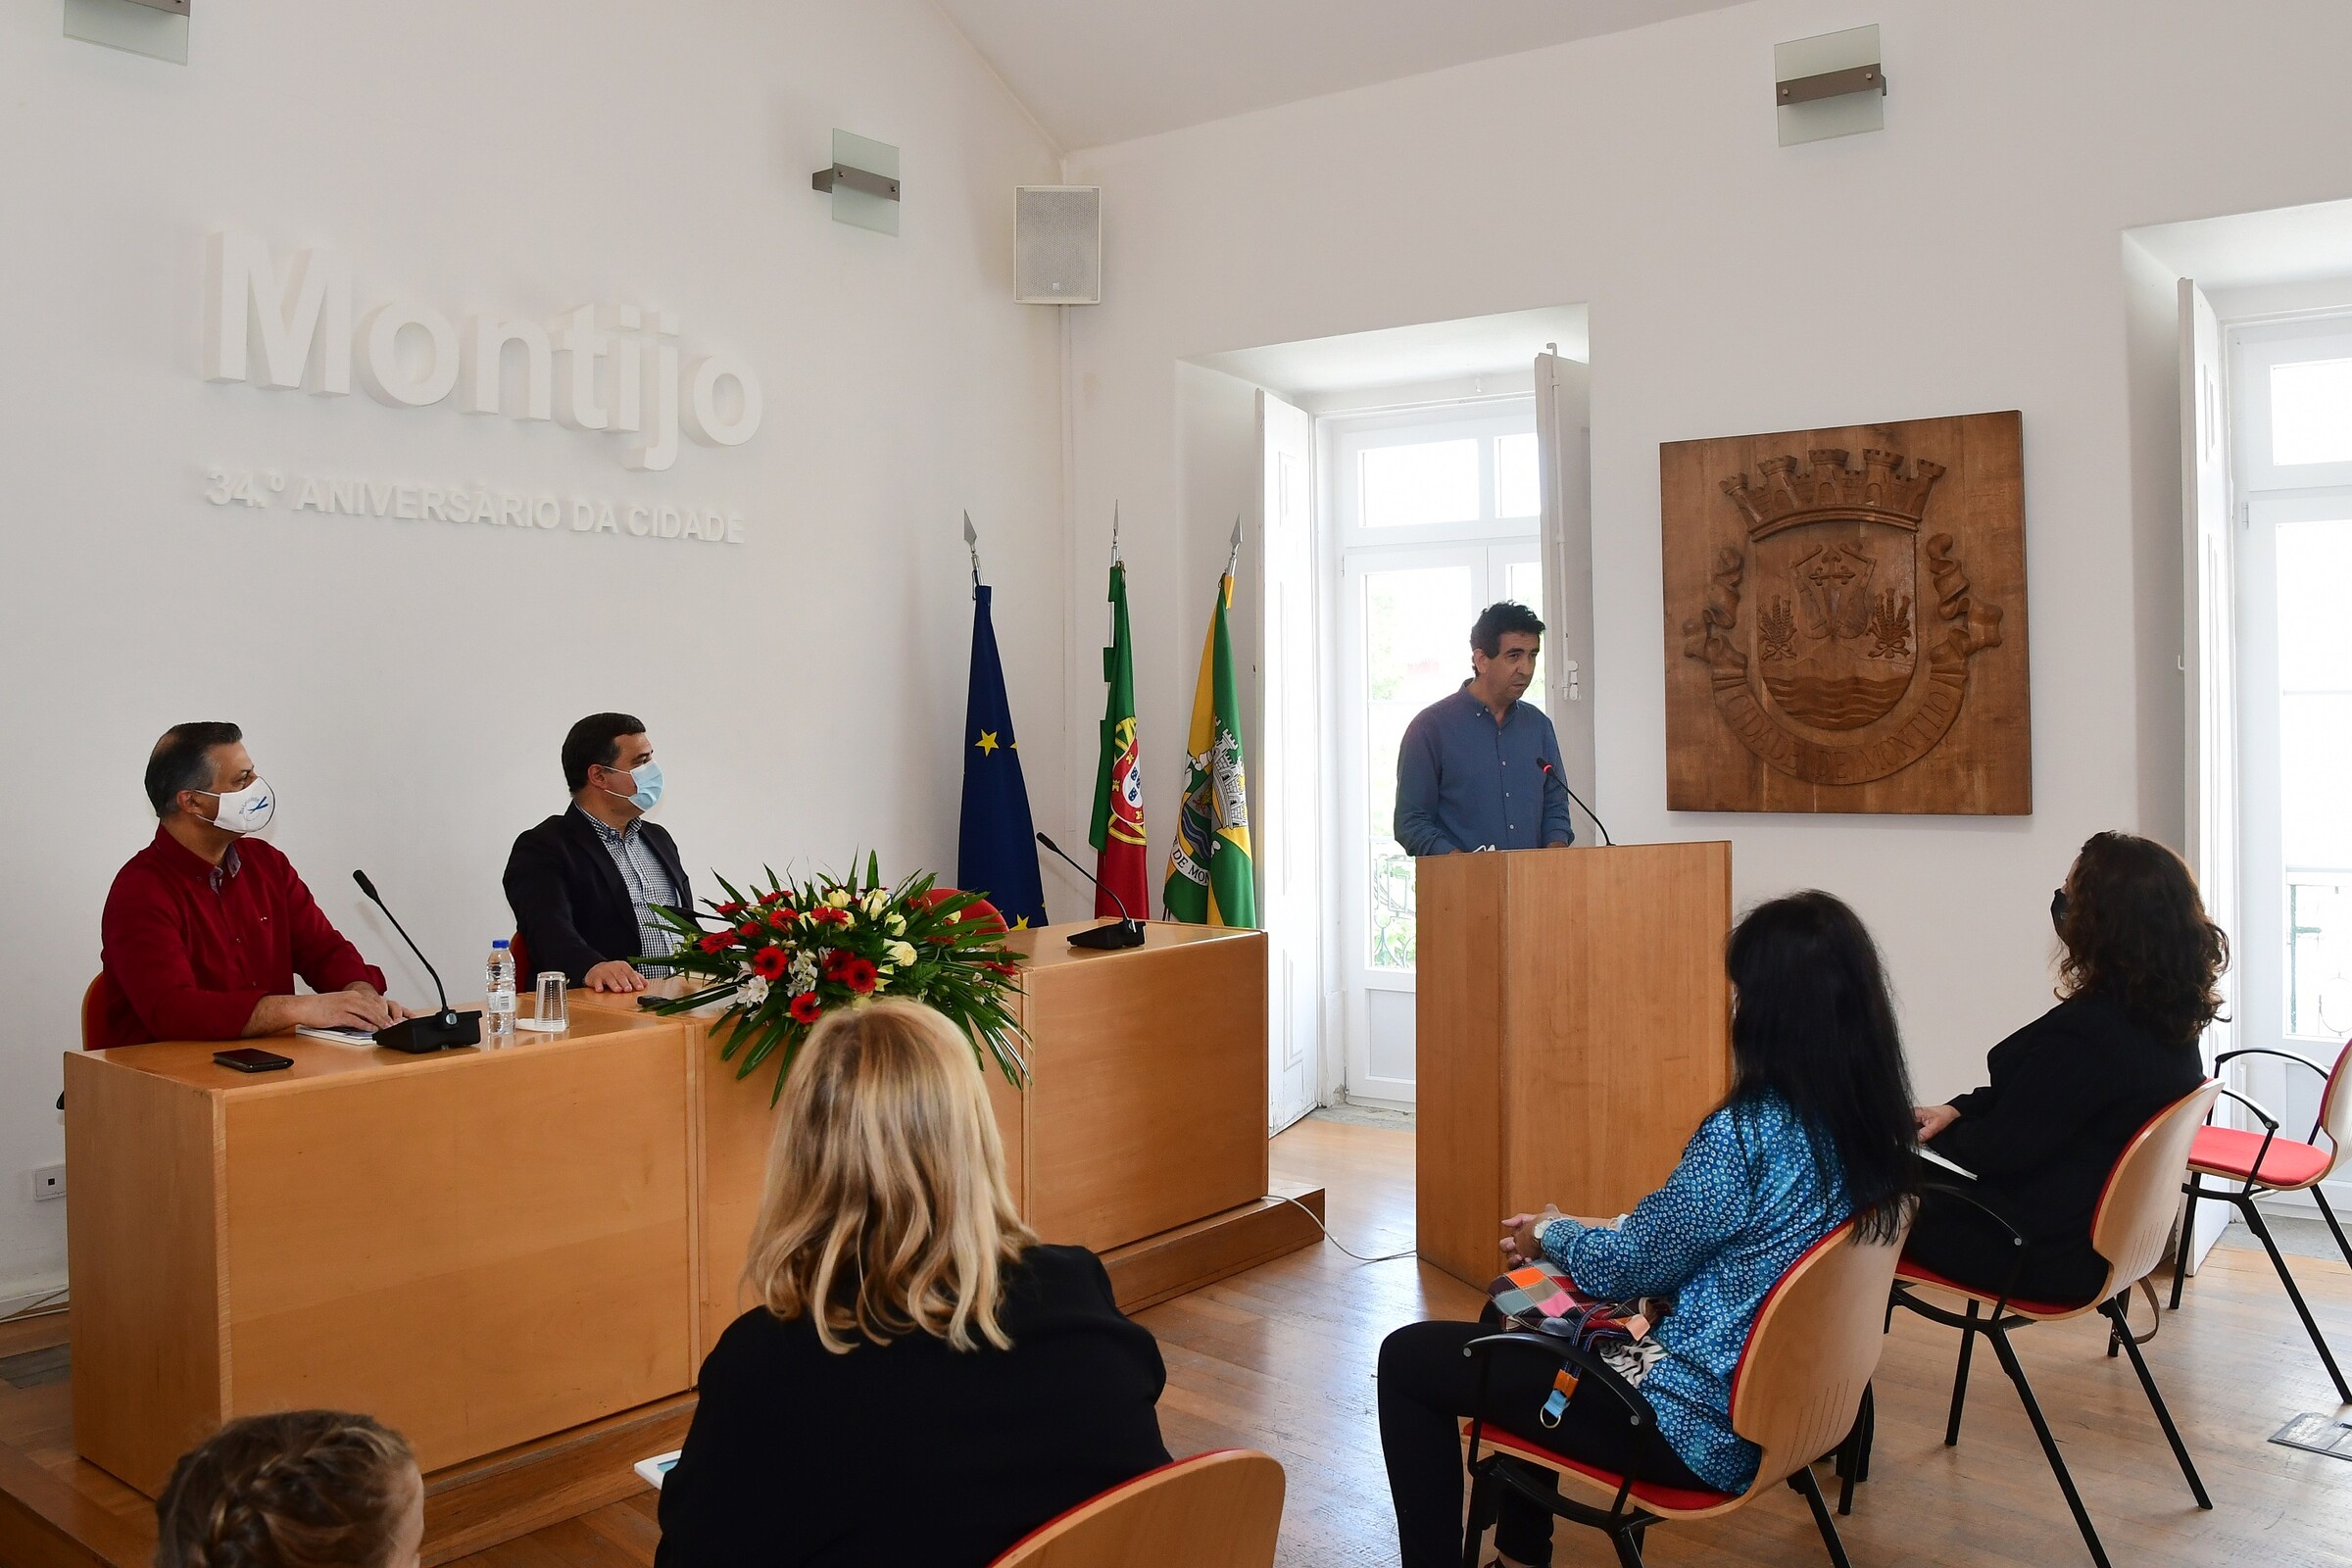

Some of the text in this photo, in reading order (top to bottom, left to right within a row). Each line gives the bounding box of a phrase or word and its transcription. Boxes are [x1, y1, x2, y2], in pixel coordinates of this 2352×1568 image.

[203, 229, 763, 472] Montijo
[292, 471, 561, 529] ANIVERSÁRIO
[570, 497, 619, 534] DA
[627, 504, 746, 545] CIDADE
[1725, 694, 1803, 771] CIDADE
[1816, 750, 1847, 779] DE
[1172, 848, 1189, 869] DE
